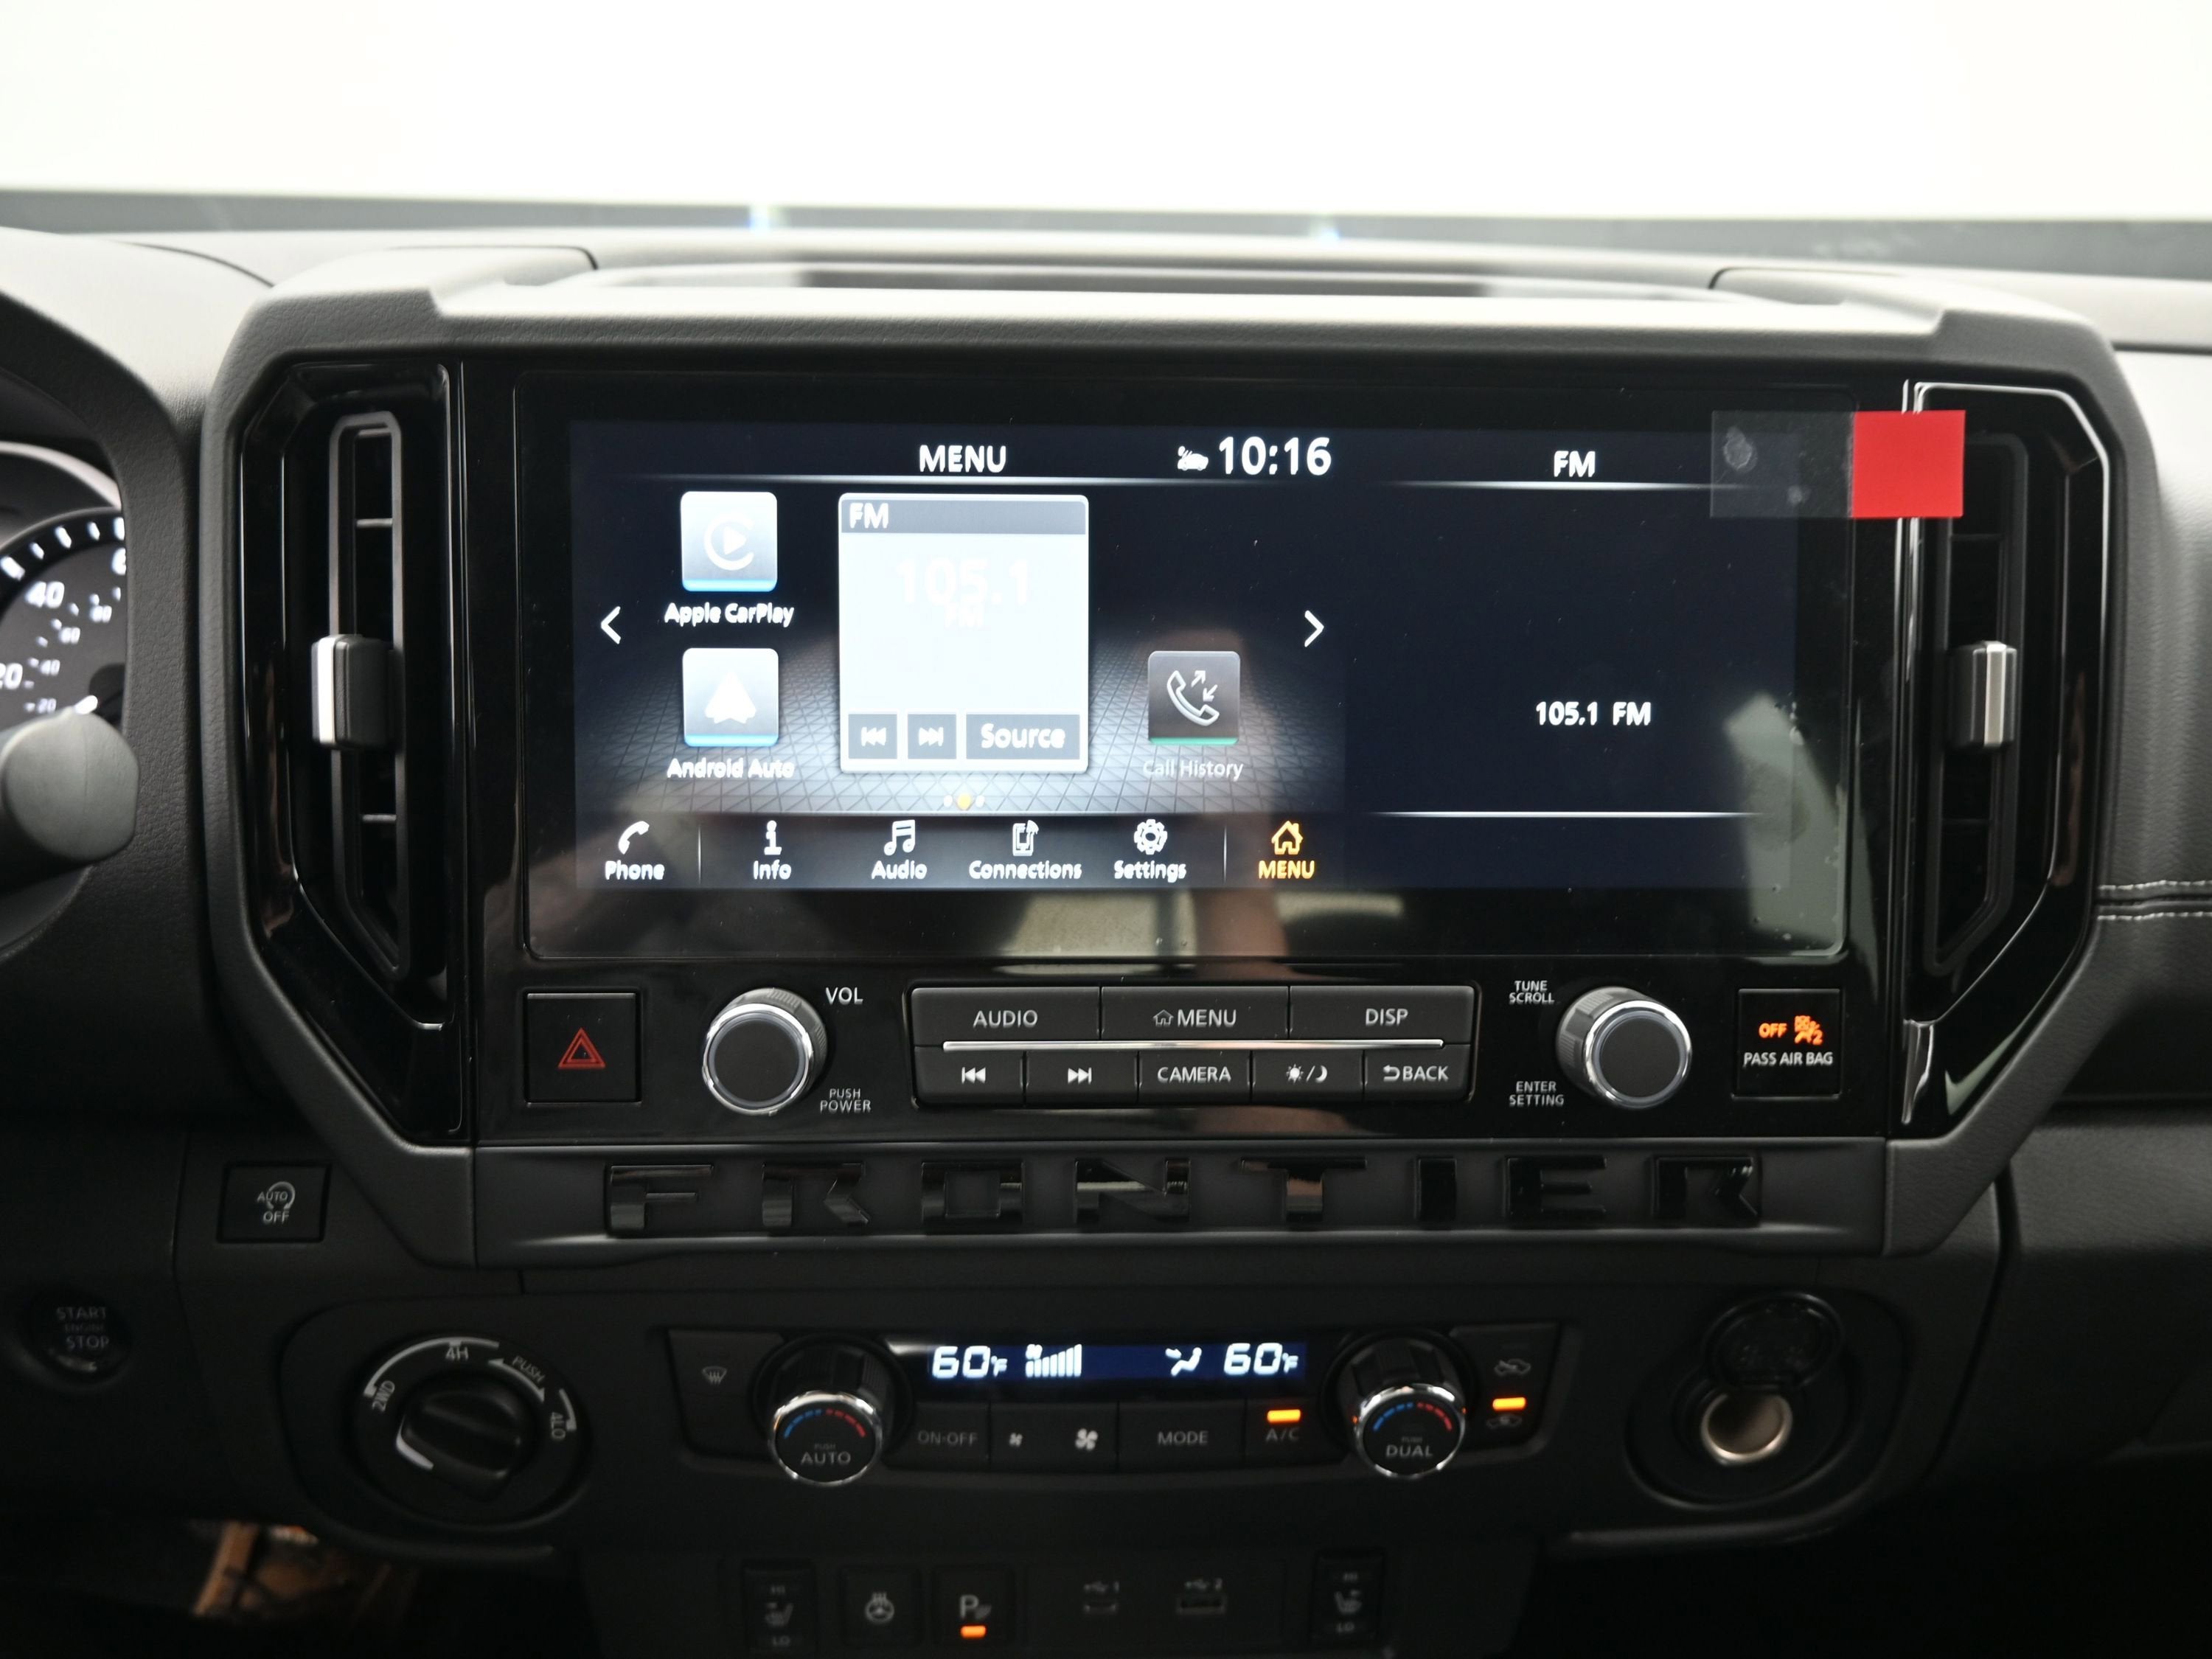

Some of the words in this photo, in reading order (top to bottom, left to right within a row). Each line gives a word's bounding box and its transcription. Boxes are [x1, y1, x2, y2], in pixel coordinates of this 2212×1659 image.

[919, 445, 1006, 473] MENU
[1219, 437, 1332, 476] 10:16
[1553, 450, 1596, 478] FM
[849, 503, 889, 529] FM
[895, 556, 1029, 608] 105.1
[25, 581, 65, 609] 40
[664, 602, 721, 627] Apple
[725, 602, 795, 628] CarPlay
[1535, 701, 1599, 726] 105.1
[1613, 701, 1652, 726] FM
[980, 723, 1066, 749] Source
[667, 757, 744, 779] Android
[748, 757, 796, 779] Auto
[1142, 759, 1175, 777] Call
[1180, 759, 1244, 782] History
[605, 860, 665, 880] Phone
[753, 860, 792, 880] Info
[871, 860, 928, 880] Audio
[968, 860, 1082, 880] Connections
[1113, 859, 1187, 883] Settings
[1258, 860, 1315, 880] MENU
[1514, 980, 1548, 992] TUNE
[825, 987, 864, 1006] VOL
[1509, 992, 1555, 1005] SCROLL
[973, 1009, 1038, 1029] AUDIO
[1177, 1007, 1237, 1027] MENU
[1364, 1006, 1409, 1026] DISP
[1758, 1022, 1788, 1039] OFF
[1743, 1051, 1777, 1067] PASS
[1779, 1051, 1804, 1066] AIR
[1806, 1051, 1834, 1066] BAG
[1156, 1065, 1232, 1083] CAMERA
[1402, 1064, 1450, 1082] BACK
[829, 1088, 862, 1100] PUSH
[1515, 1080, 1557, 1093] ENTER
[819, 1098, 872, 1114] POWER
[1509, 1093, 1565, 1107] SETTING
[257, 1191, 289, 1202] AUTO
[606, 1156, 1763, 1233] FRONTIER
[262, 1210, 290, 1225] OFF
[55, 1306, 108, 1321] START
[66, 1335, 111, 1352] STOP
[445, 1346, 469, 1362] 4H
[512, 1354, 546, 1384] PUSH
[372, 1380, 396, 1413] 2WD
[1157, 1430, 1208, 1447] MODE
[1265, 1427, 1301, 1444] A/C
[799, 1450, 852, 1467] AUTO
[1385, 1444, 1434, 1459] DUAL
